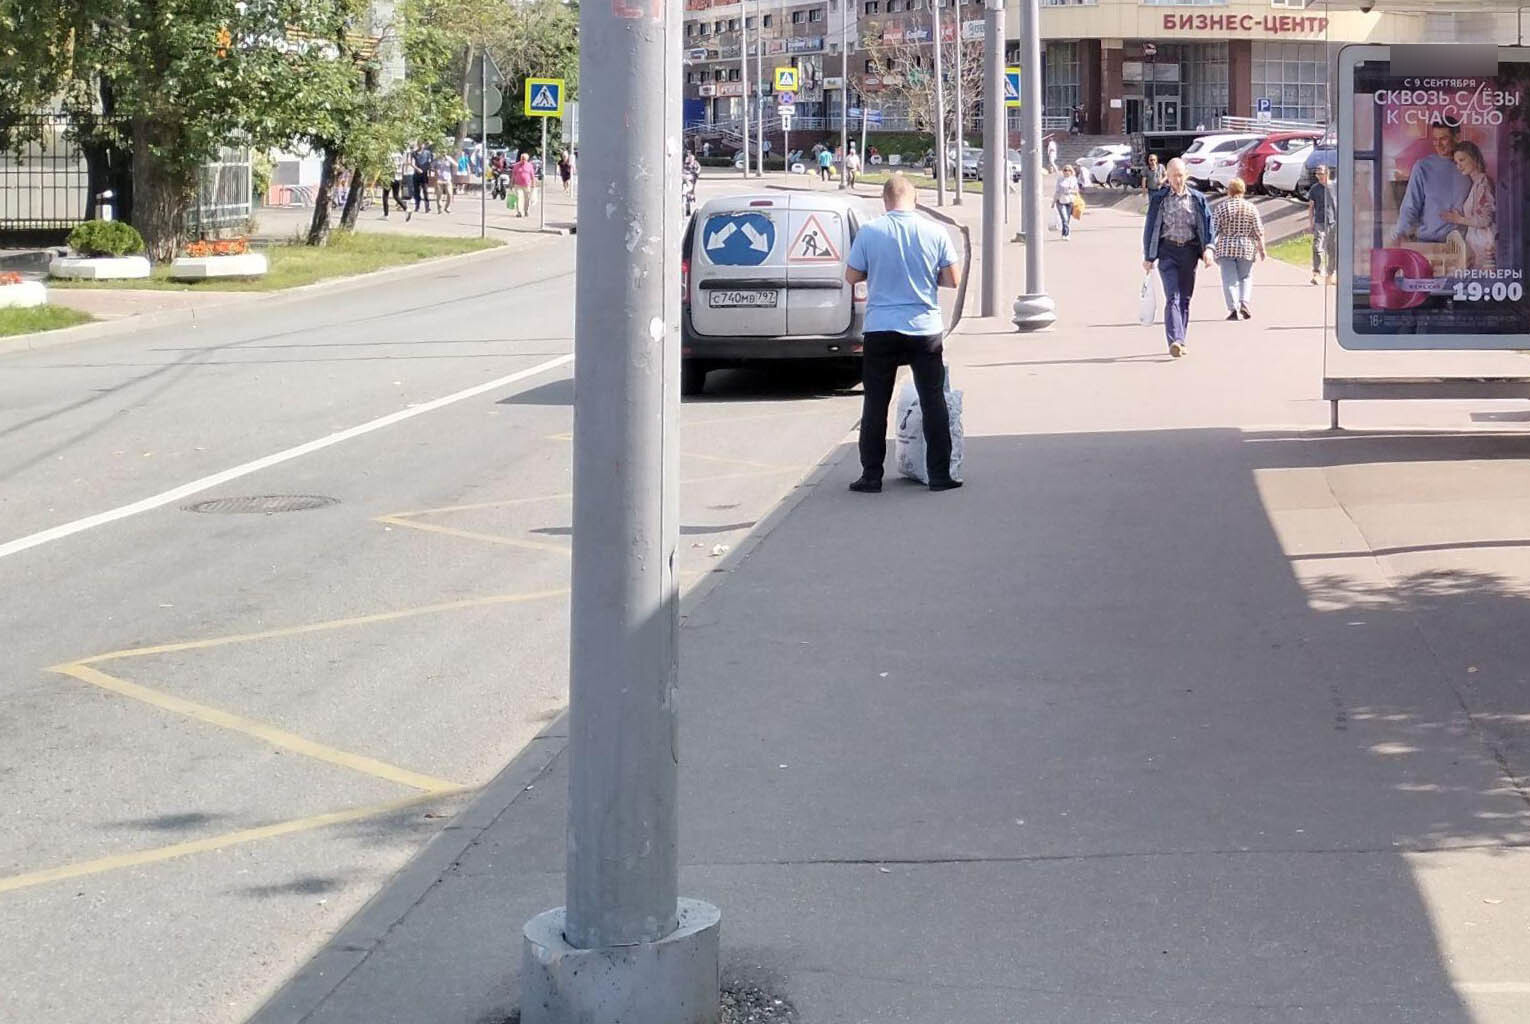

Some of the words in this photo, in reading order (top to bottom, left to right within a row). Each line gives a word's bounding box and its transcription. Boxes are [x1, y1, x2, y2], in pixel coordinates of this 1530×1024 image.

[1163, 14, 1329, 34] БИЗНЕС-ЦЕНТР
[1404, 78, 1412, 88] С
[1414, 78, 1421, 88] 9
[1423, 78, 1476, 88] СЕНТЯБРЯ
[1374, 90, 1450, 106] СКВОЗЬ
[1455, 82, 1520, 113] СЛЁЗЫ
[1387, 109, 1399, 125] К
[1404, 105, 1503, 127] СЧАСТЬЮ
[1454, 269, 1523, 279] ПРЕМЬЕРЫ
[1453, 282, 1523, 302] 19:00
